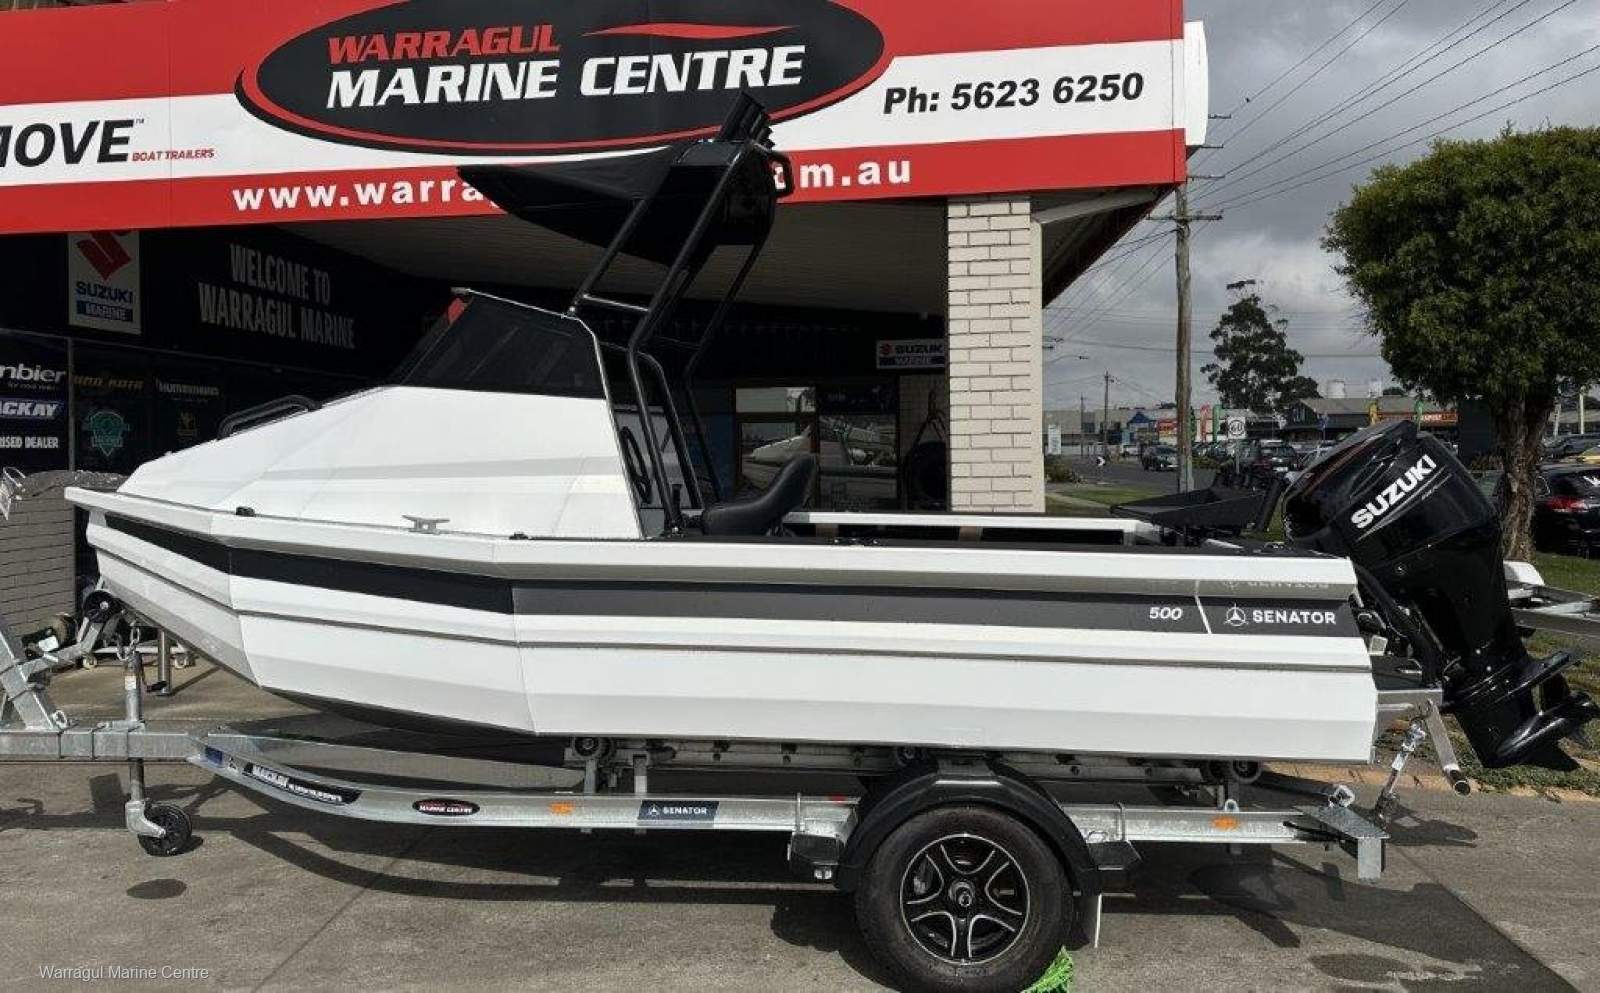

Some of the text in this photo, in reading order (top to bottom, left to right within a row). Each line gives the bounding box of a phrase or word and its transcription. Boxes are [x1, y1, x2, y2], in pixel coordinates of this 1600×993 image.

[327, 24, 560, 64] WARRAGUL
[326, 45, 805, 109] MARINE CENTRE
[884, 72, 1145, 115] Ph: 5623 6250
[0, 119, 134, 168] OVE
[132, 148, 215, 162] BOAT TRAILERS
[76, 280, 134, 305] SUZUKI
[229, 243, 331, 305] WELCOME TO
[198, 281, 355, 350] WARRAGUL MARINE
[0, 401, 58, 416] CKAY
[25, 436, 59, 449] DEALER
[1351, 454, 1437, 529] SUZUKI
[1149, 606, 1337, 625] 500 SENATOR
[662, 806, 707, 816] SENATOR
